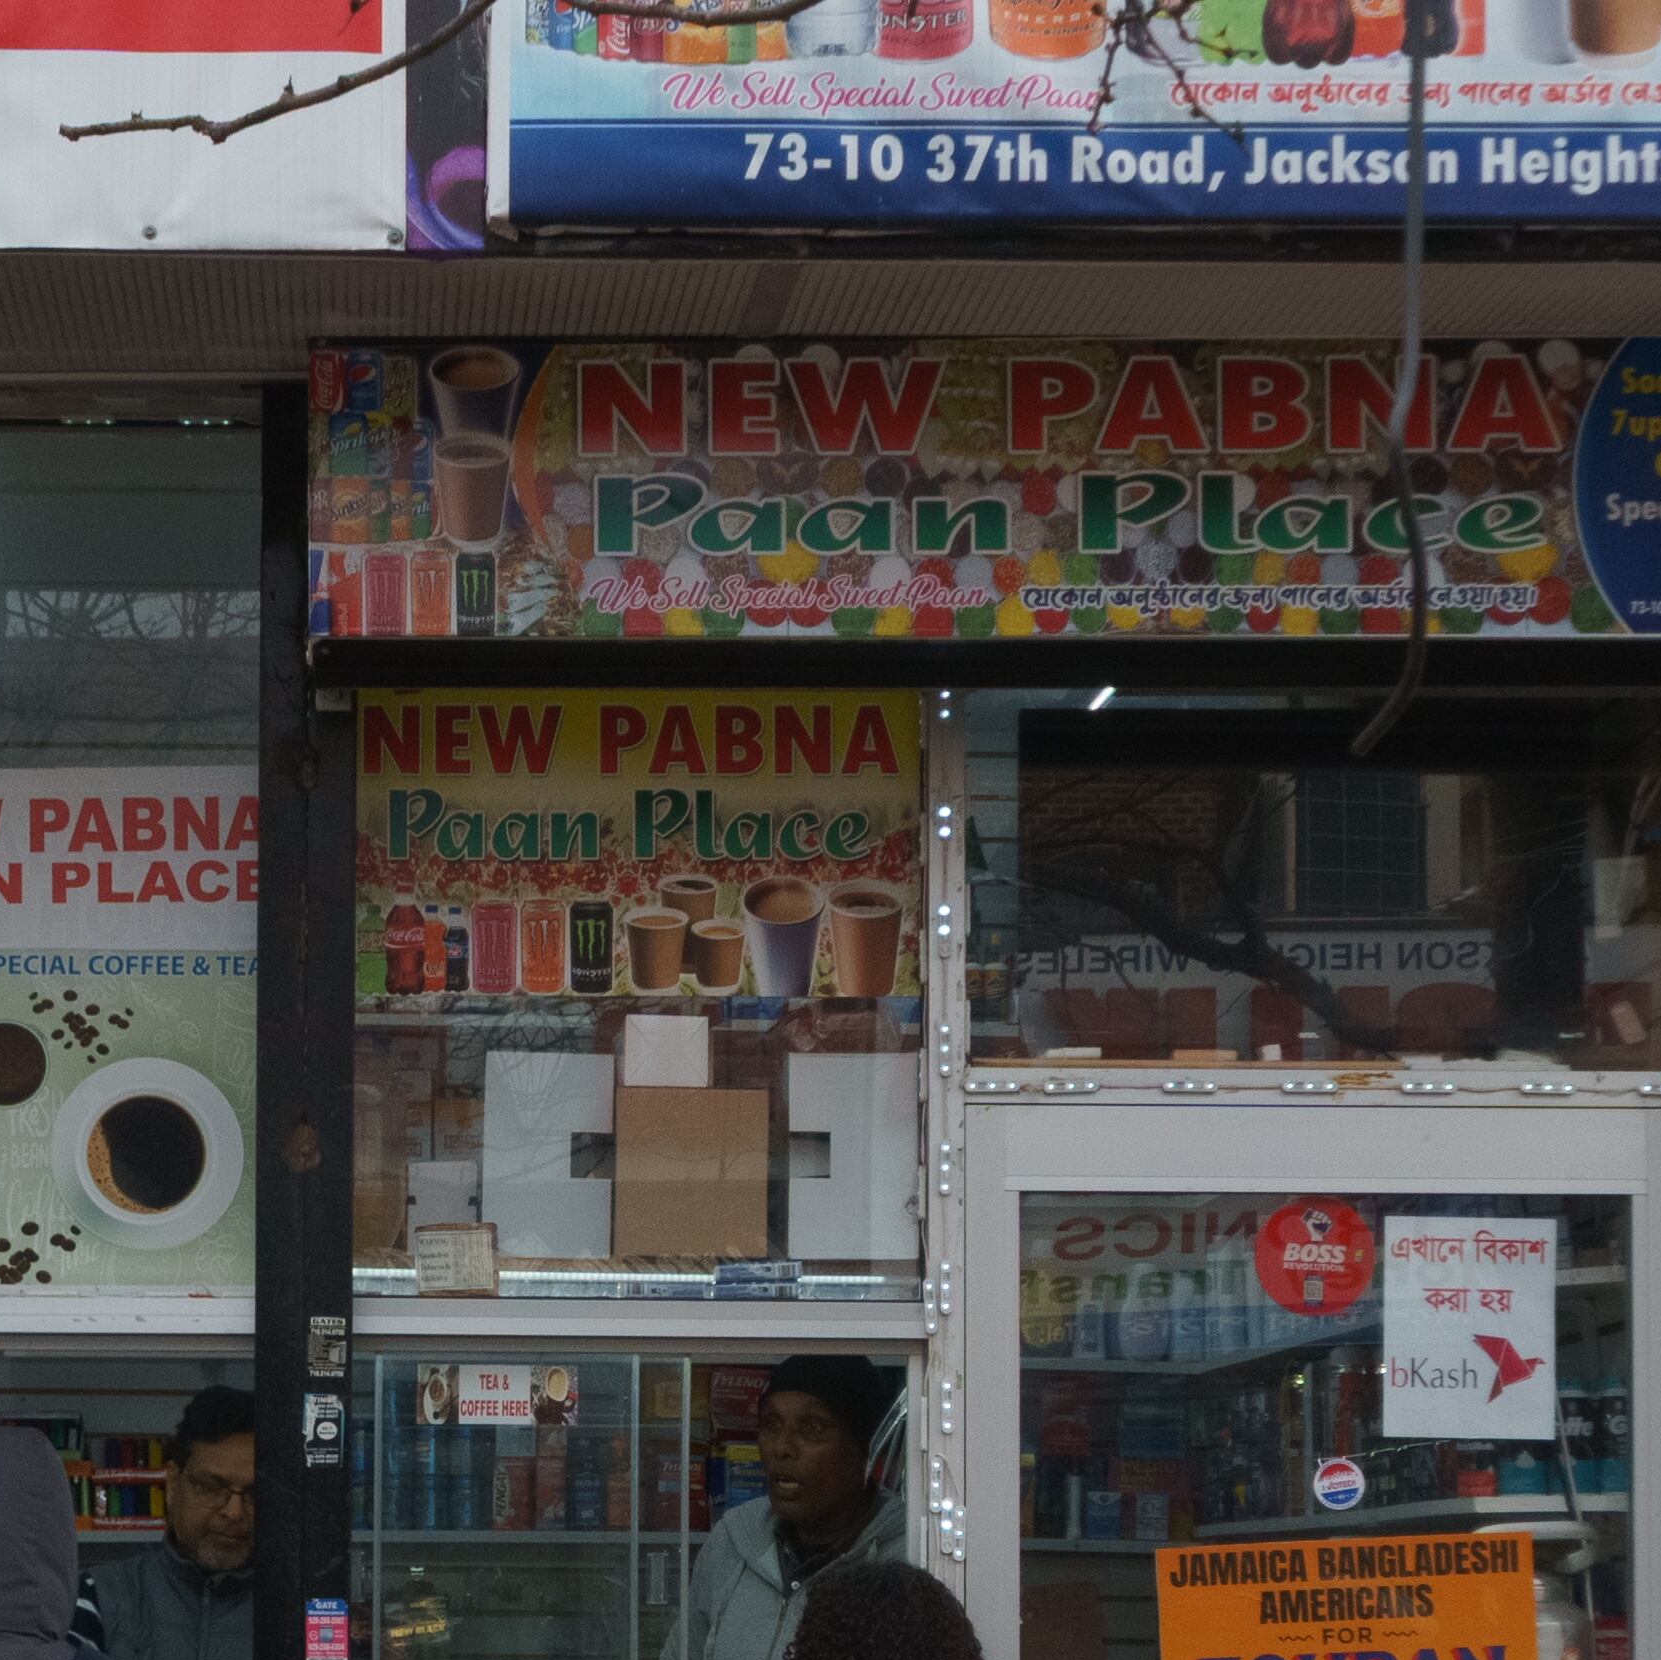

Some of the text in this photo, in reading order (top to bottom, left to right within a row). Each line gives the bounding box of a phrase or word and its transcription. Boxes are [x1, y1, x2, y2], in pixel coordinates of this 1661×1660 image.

[663, 71, 1015, 117] We Sell Special Sweet
[742, 132, 905, 182] 73-10
[925, 133, 1049, 183] 37th
[1070, 135, 1224, 192] Road,
[577, 355, 1561, 457] NEW PABNA
[592, 469, 1548, 557] Paan Place
[87, 955, 186, 976] COFFEE
[192, 956, 212, 976] &
[1284, 1241, 1348, 1265] BOSS
[1390, 1229, 1548, 1265] এখানে বিকাশ
[1423, 1286, 1515, 1315] করা হয়
[478, 1372, 510, 1392] TEA &
[1390, 1355, 1479, 1391] bKash
[459, 1399, 530, 1418] COFFEE HERE
[1169, 1539, 1520, 1588] JAMAICA BANGLADESHI
[1260, 1583, 1435, 1625] AMERICANS
[1322, 1626, 1374, 1646] FOR
